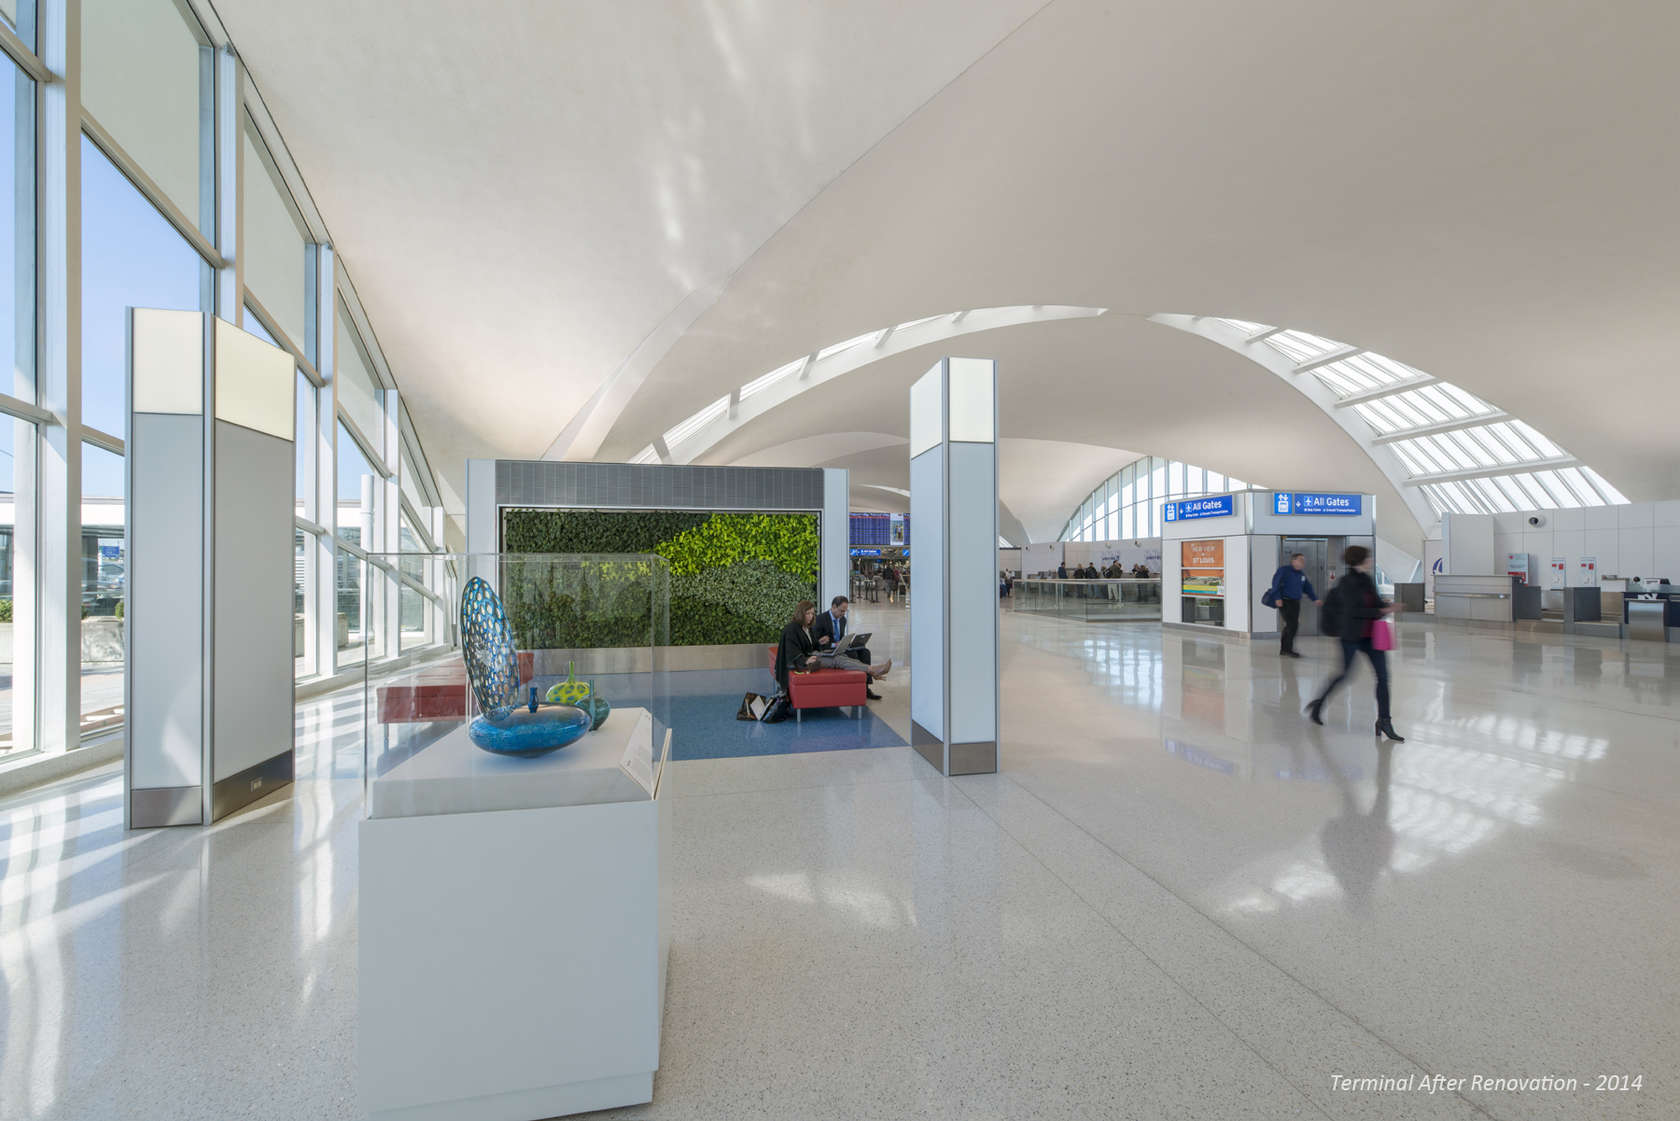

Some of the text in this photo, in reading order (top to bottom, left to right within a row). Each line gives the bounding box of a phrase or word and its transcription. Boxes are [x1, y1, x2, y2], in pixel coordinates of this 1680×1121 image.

[1193, 500, 1222, 511] All Gates
[1313, 497, 1350, 506] All Gates
